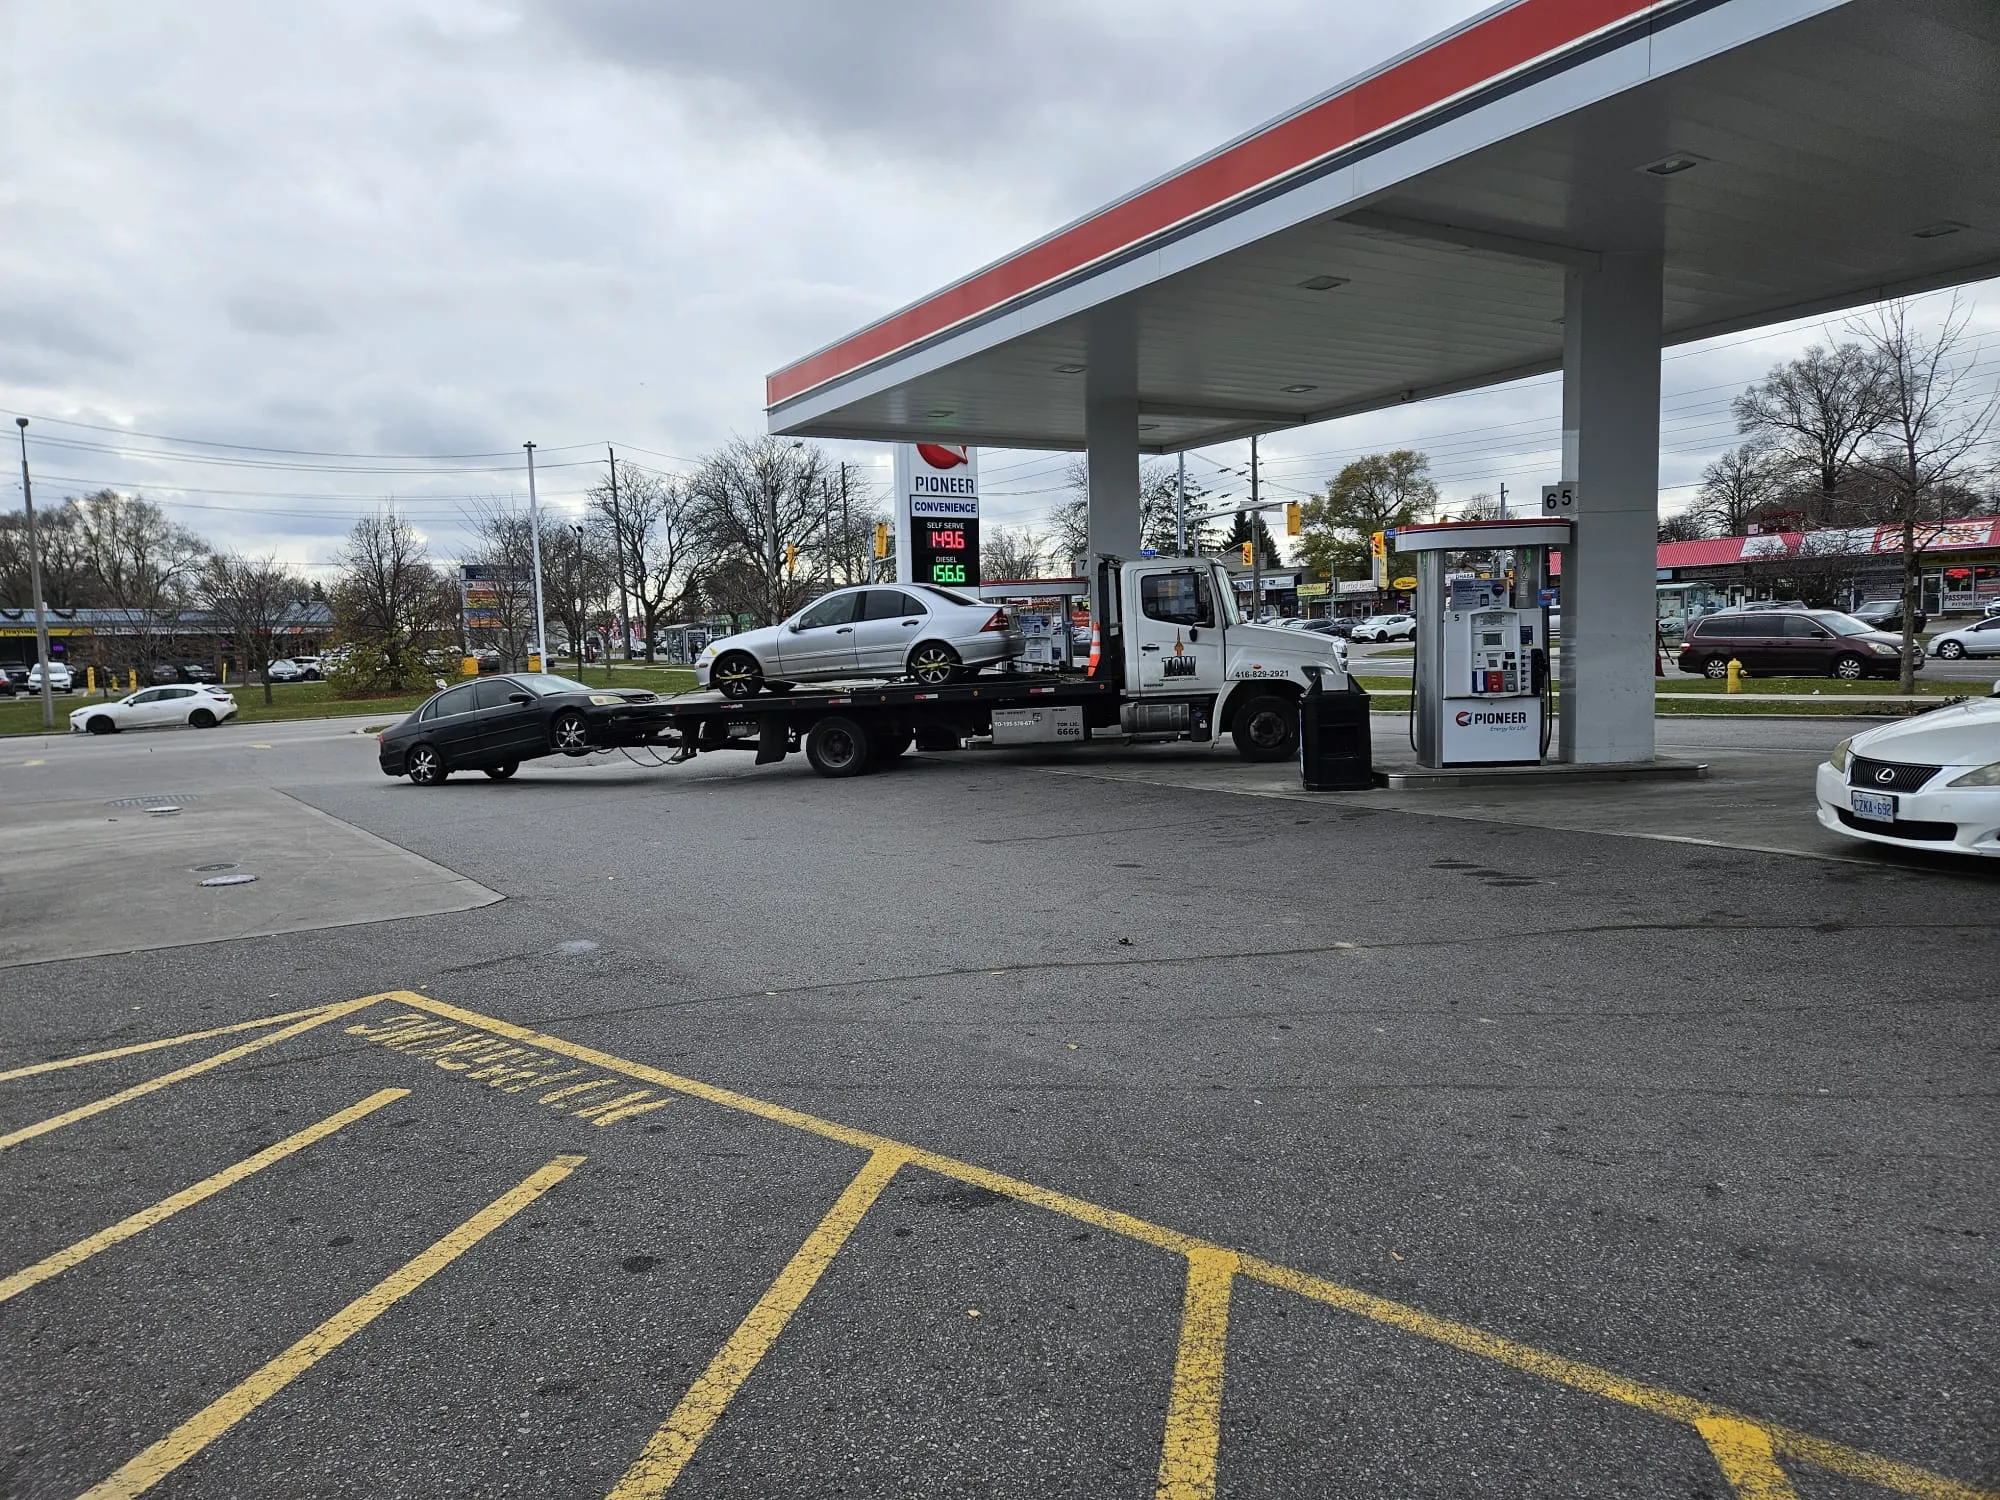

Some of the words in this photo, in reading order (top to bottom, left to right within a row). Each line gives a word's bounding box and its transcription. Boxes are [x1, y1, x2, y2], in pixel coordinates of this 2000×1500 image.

[915, 476, 974, 494] PIONEER
[1546, 493, 1557, 510] 6
[1561, 489, 1572, 506] 5
[914, 501, 977, 513] CONVENIENCE
[927, 521, 943, 529] SELF
[944, 522, 965, 530] SERVE
[932, 531, 965, 549] 149.6
[1080, 559, 1088, 571] 7
[933, 564, 965, 582] 156.6
[1162, 656, 1197, 677] TOW
[1235, 670, 1289, 678] 416-829-2921
[1474, 712, 1527, 725] PIONEER
[1057, 728, 1080, 736] 6666
[1490, 725, 1508, 733] Energy
